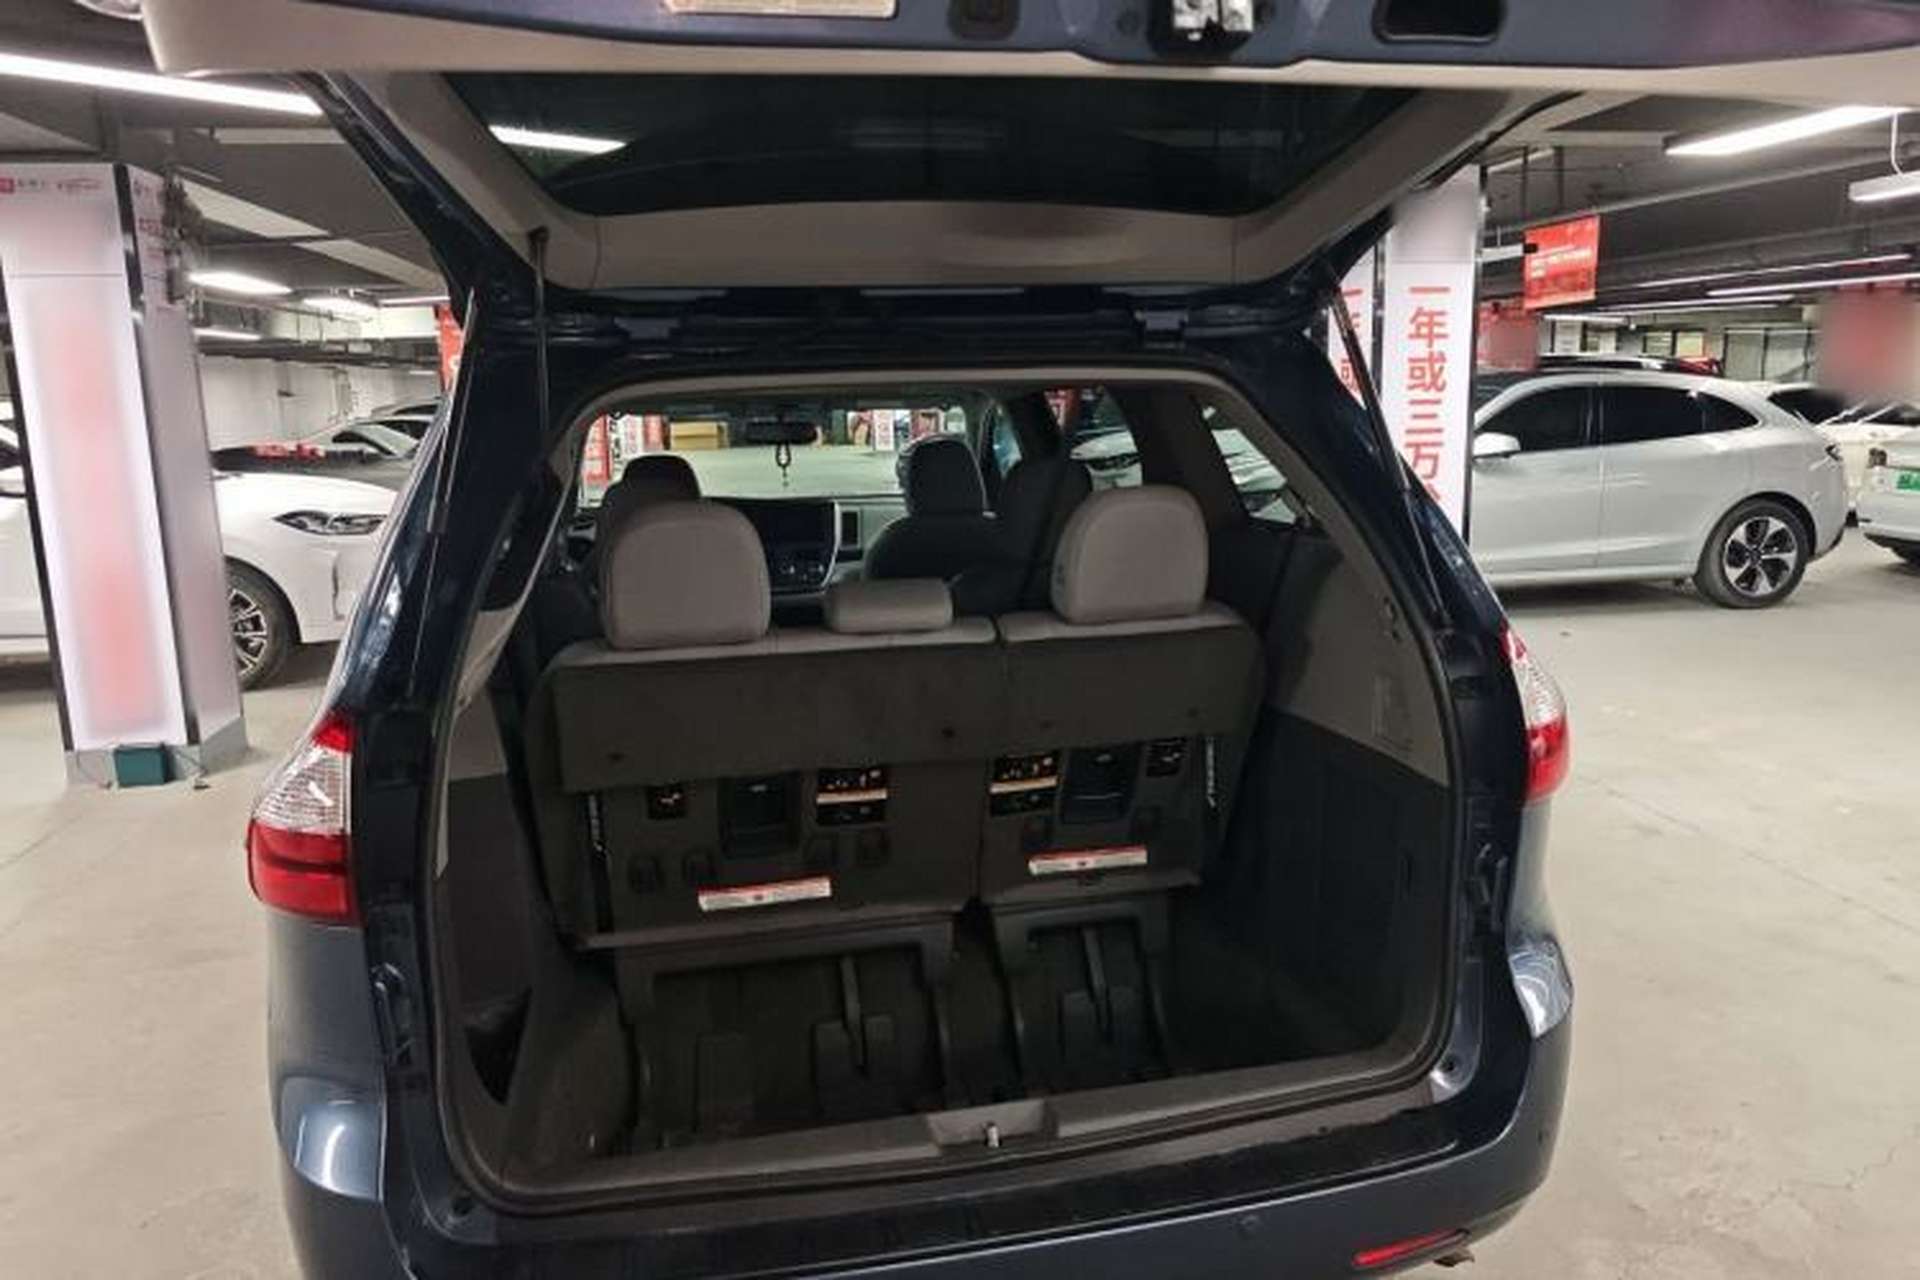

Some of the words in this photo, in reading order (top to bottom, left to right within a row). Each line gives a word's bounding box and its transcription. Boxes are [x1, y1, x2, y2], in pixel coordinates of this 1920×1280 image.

[1404, 285, 1451, 501] 一年或三万
